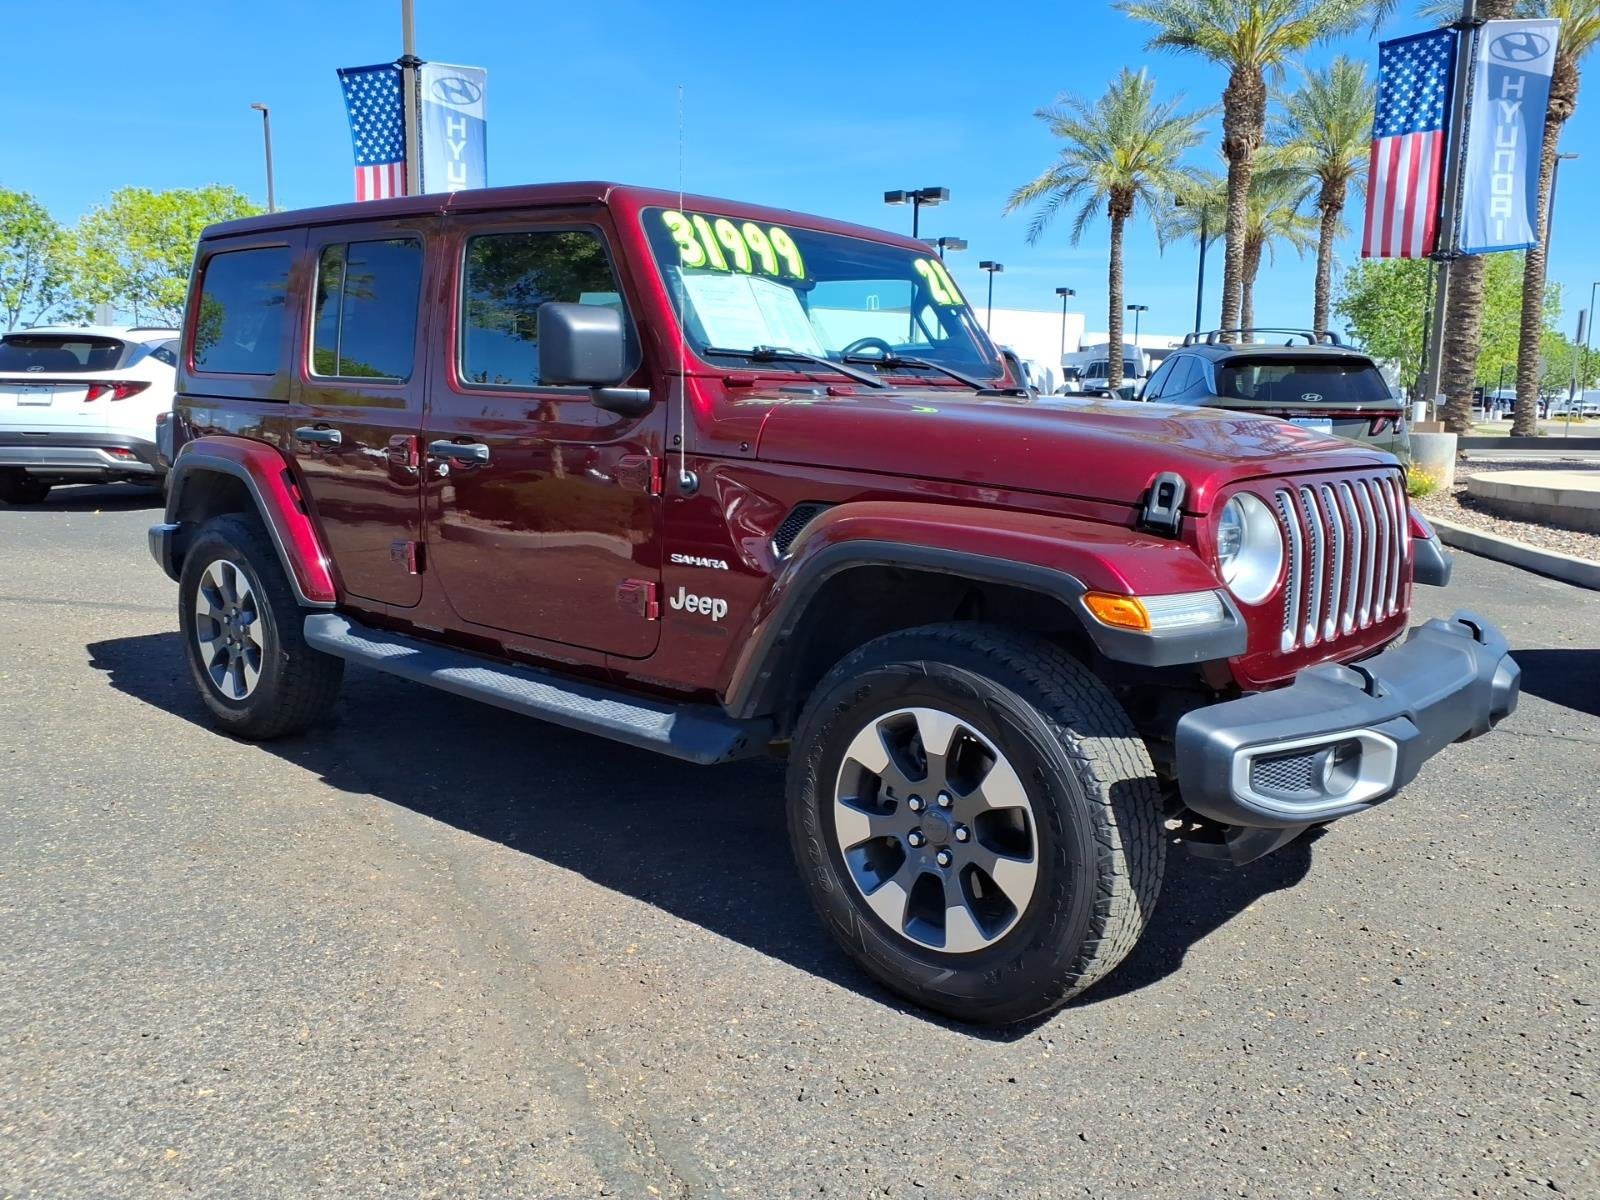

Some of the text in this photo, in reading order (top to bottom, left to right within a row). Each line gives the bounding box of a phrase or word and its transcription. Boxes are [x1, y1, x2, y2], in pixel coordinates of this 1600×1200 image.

[447, 117, 467, 192] HYU
[1491, 75, 1525, 241] HYUNDAI
[662, 210, 805, 279] 31999
[914, 258, 964, 305] 21
[671, 553, 729, 570] SAHARA
[669, 586, 728, 621] Jeep
